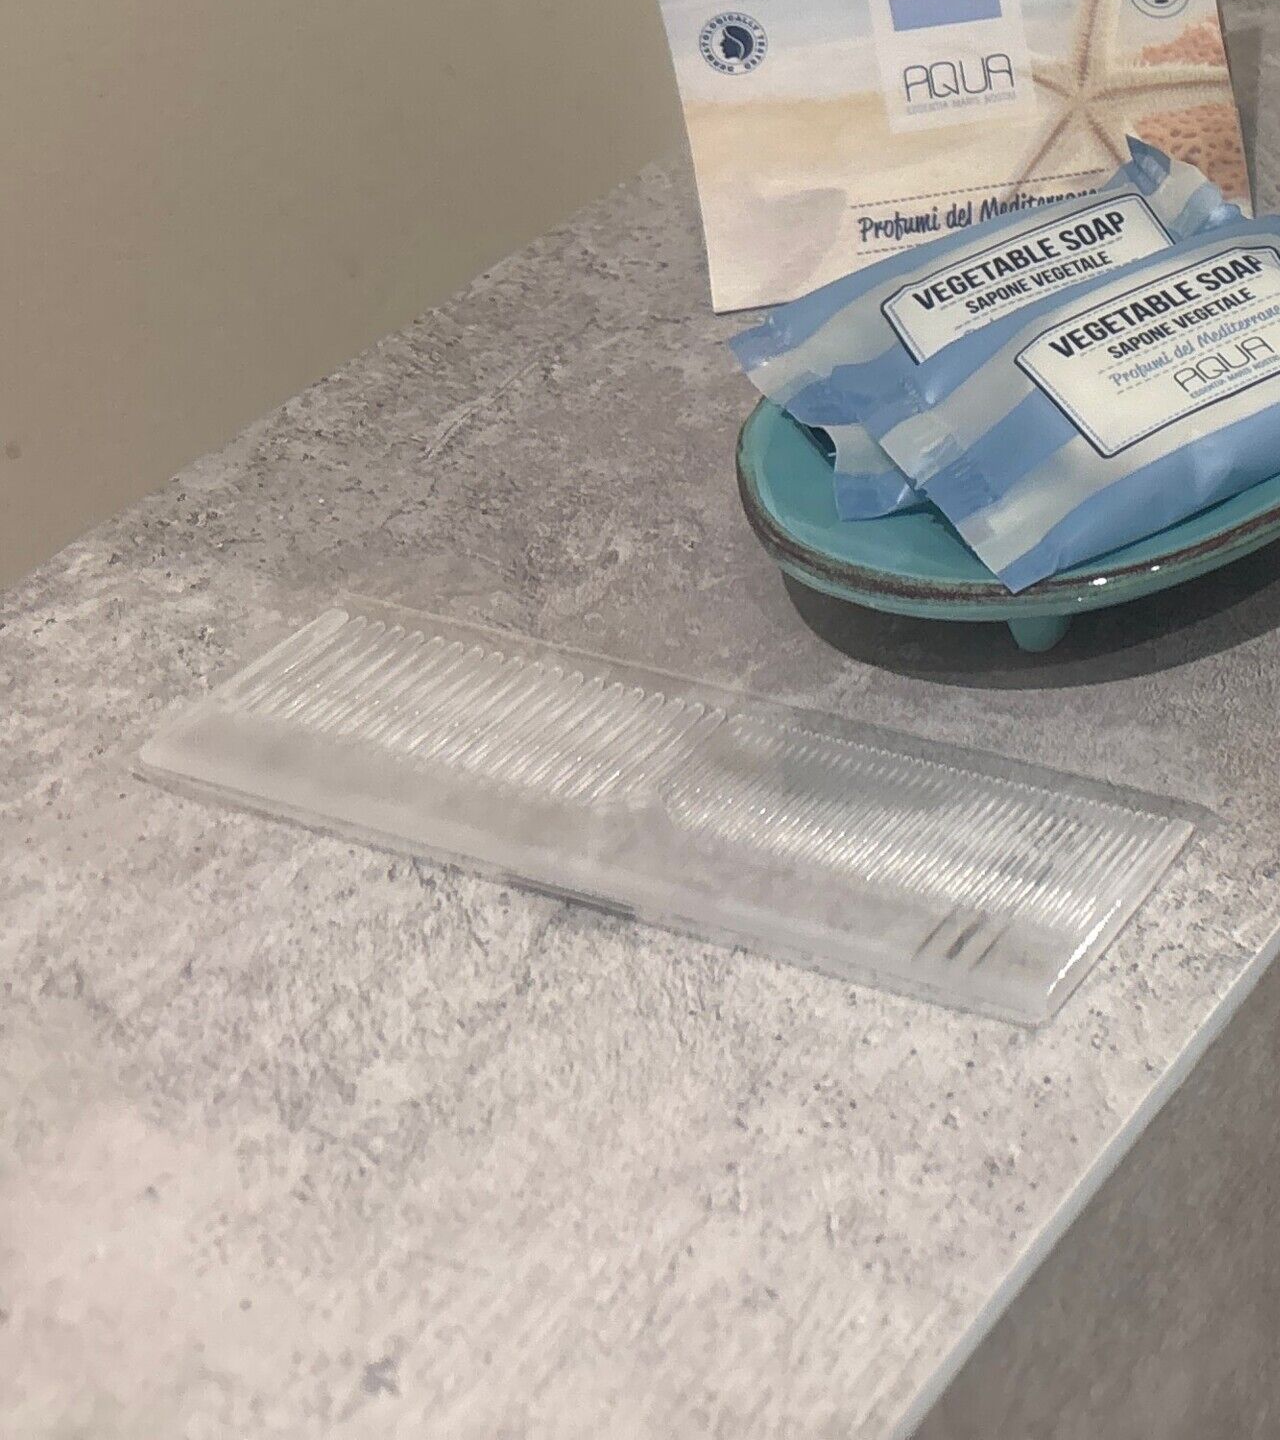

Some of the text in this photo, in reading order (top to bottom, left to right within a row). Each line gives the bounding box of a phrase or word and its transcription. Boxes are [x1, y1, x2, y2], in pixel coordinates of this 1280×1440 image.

[903, 52, 1015, 103] AQUA
[858, 207, 942, 243] Profumi
[946, 202, 973, 229] del
[911, 211, 1125, 311] VEGETABLE SOAP
[965, 250, 1113, 314] SAPONE VEGETALE
[1048, 254, 1263, 359] VEGETABLE SOAP
[1107, 287, 1257, 359] SAPONE VEGETALE
[1109, 351, 1172, 387] Profumi
[1174, 340, 1195, 359] del
[1173, 336, 1275, 393] AQUA
